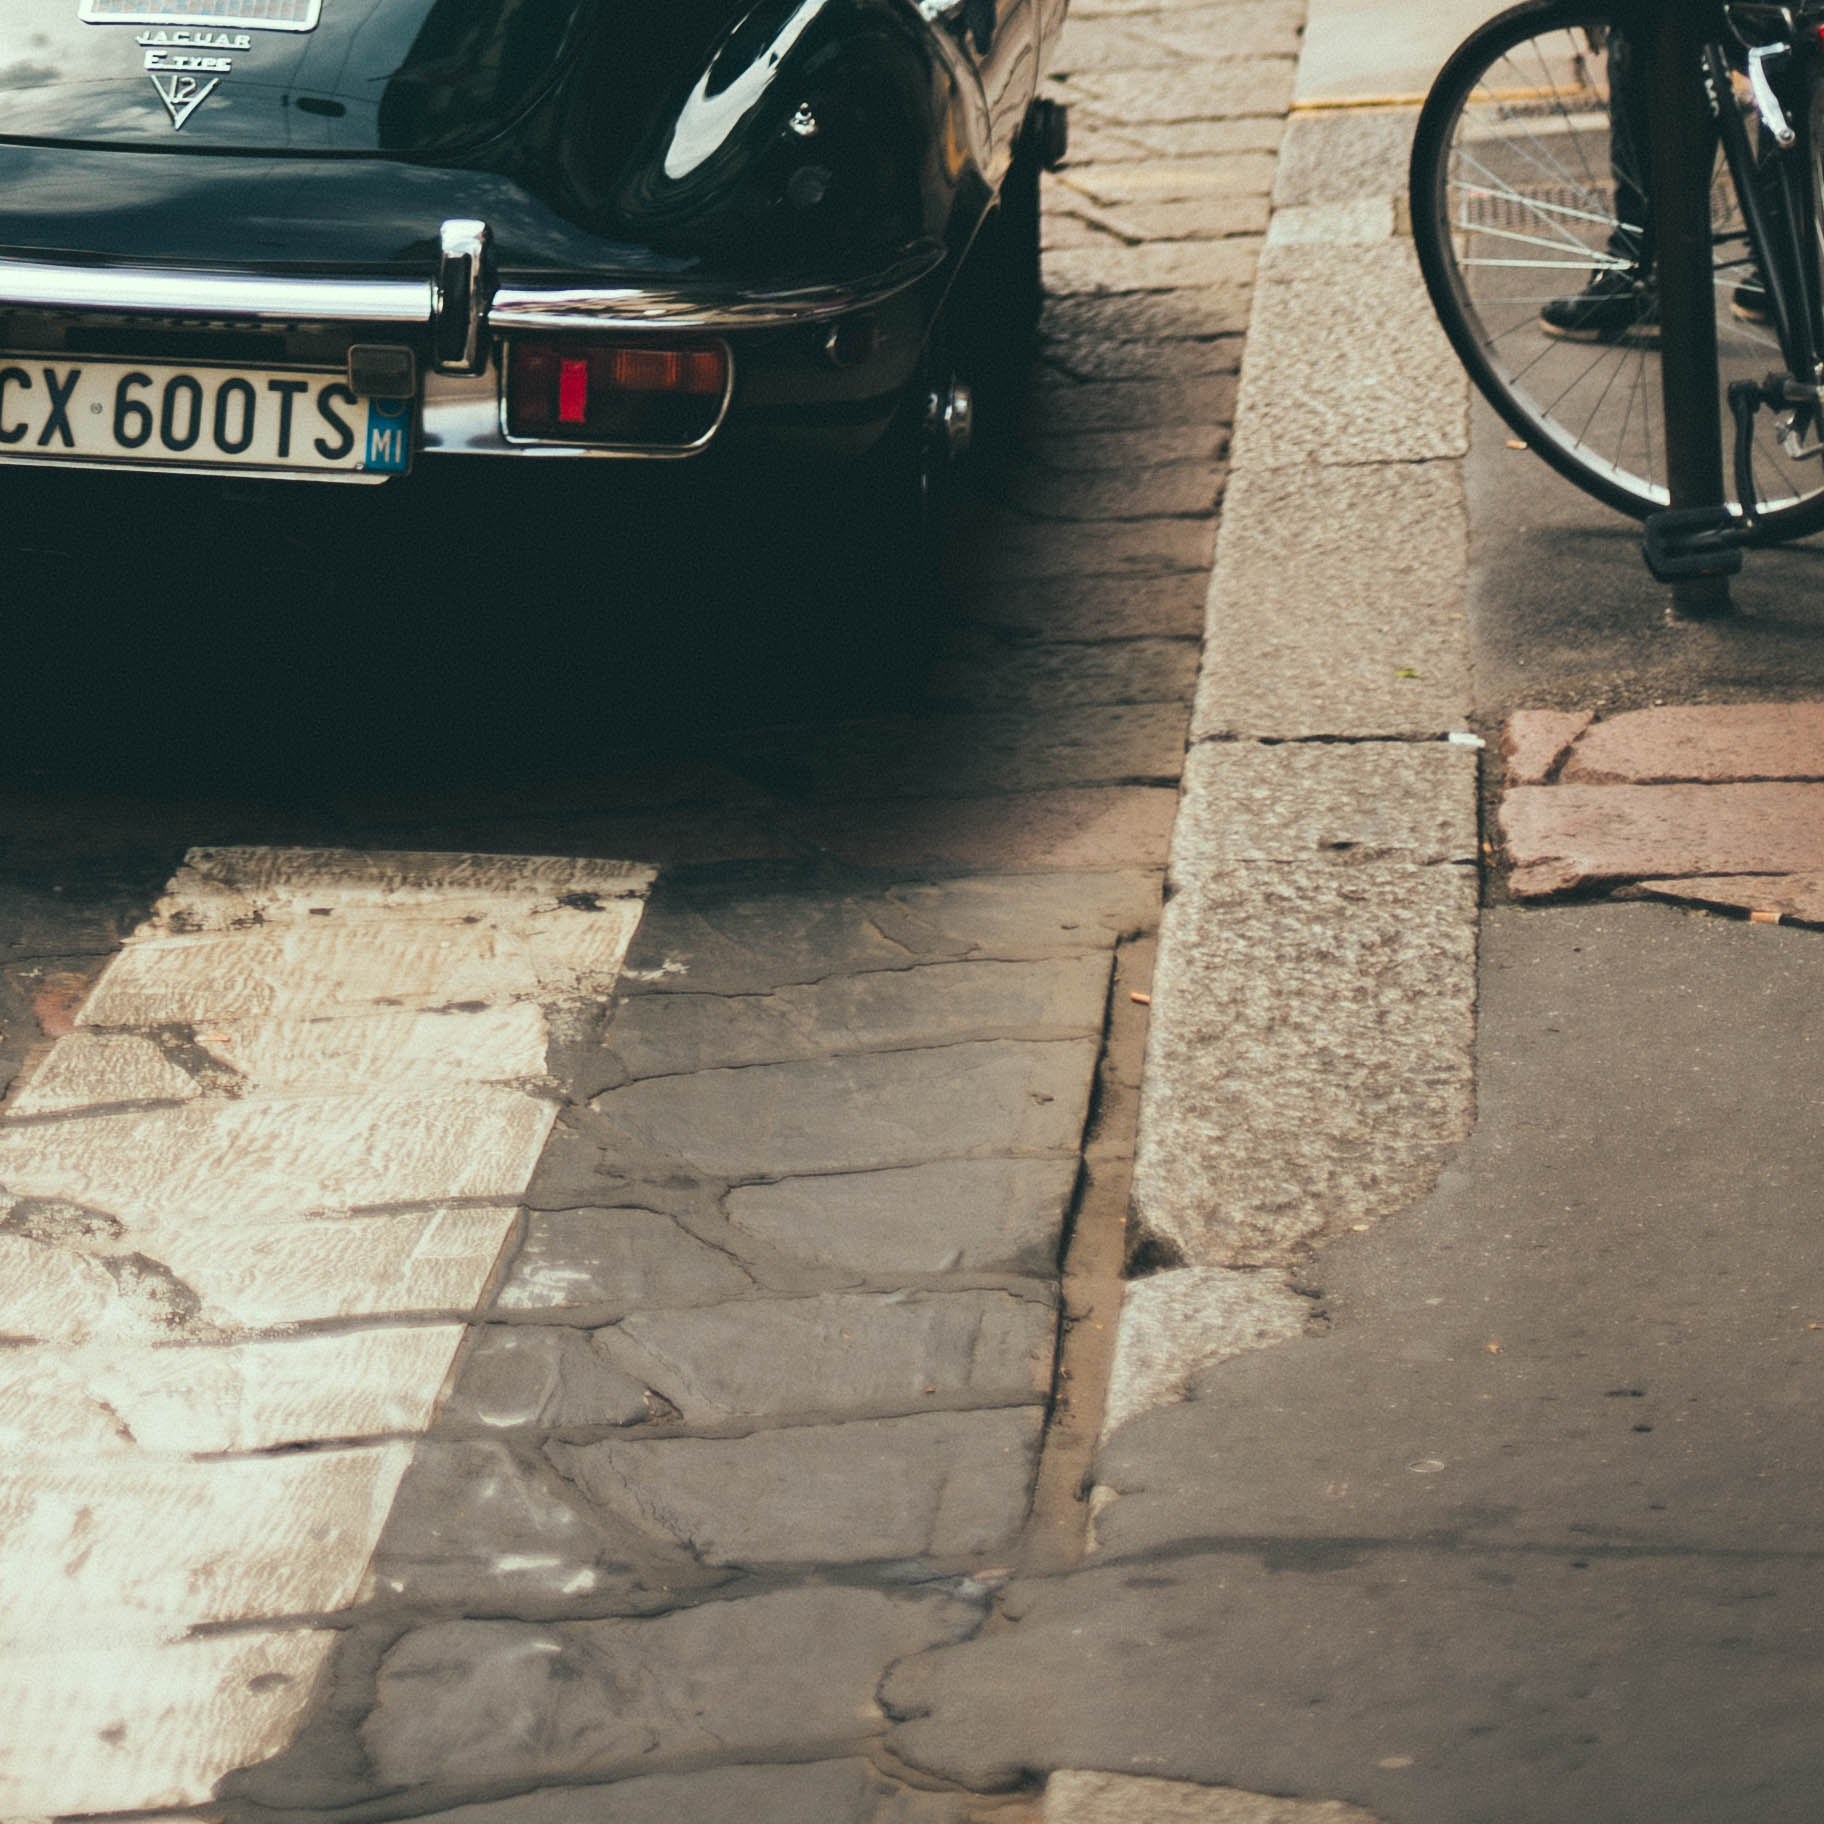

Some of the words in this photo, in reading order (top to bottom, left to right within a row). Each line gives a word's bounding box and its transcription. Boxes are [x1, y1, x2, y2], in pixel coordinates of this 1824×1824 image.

[135, 31, 251, 50] JAGUAR
[113, 372, 358, 461] 600TS
[371, 428, 403, 464] MI
